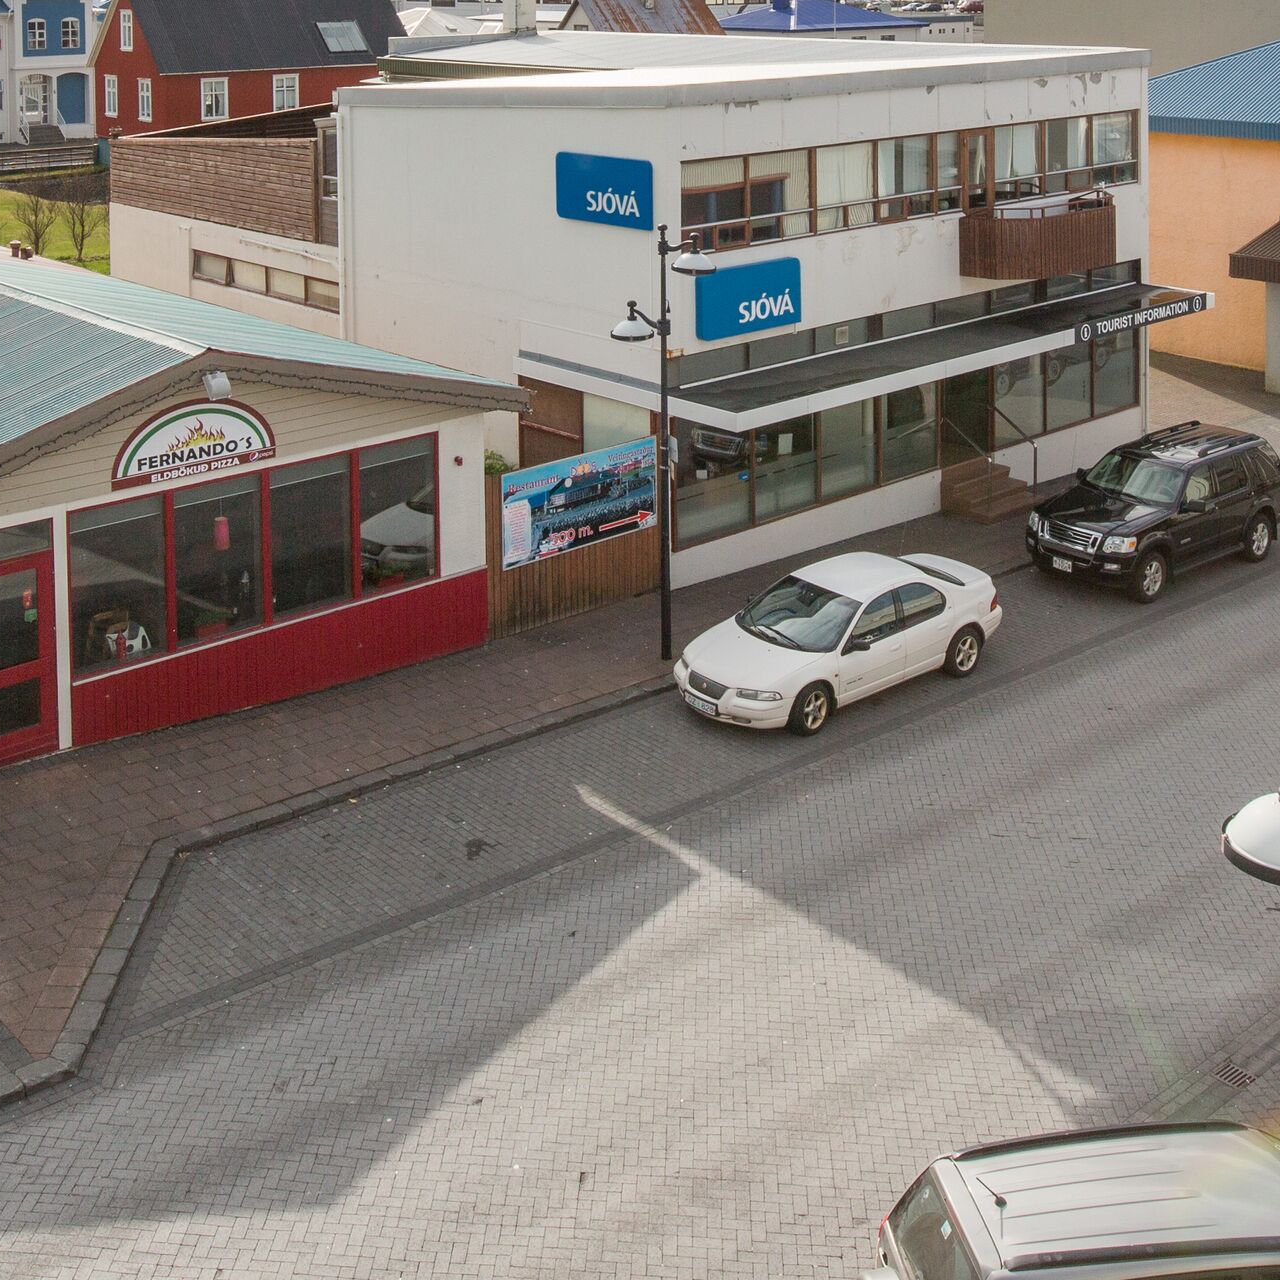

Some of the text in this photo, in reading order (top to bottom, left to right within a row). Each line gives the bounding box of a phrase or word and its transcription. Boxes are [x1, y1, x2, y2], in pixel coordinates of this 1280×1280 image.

[586, 187, 640, 218] SJÓVÁ
[738, 288, 794, 324] SJÓVÁ
[1096, 300, 1189, 335] TOURIST INFORMATION
[151, 457, 240, 483] ELDBÖKUÐ PIZZA
[507, 475, 560, 495] Restaurant
